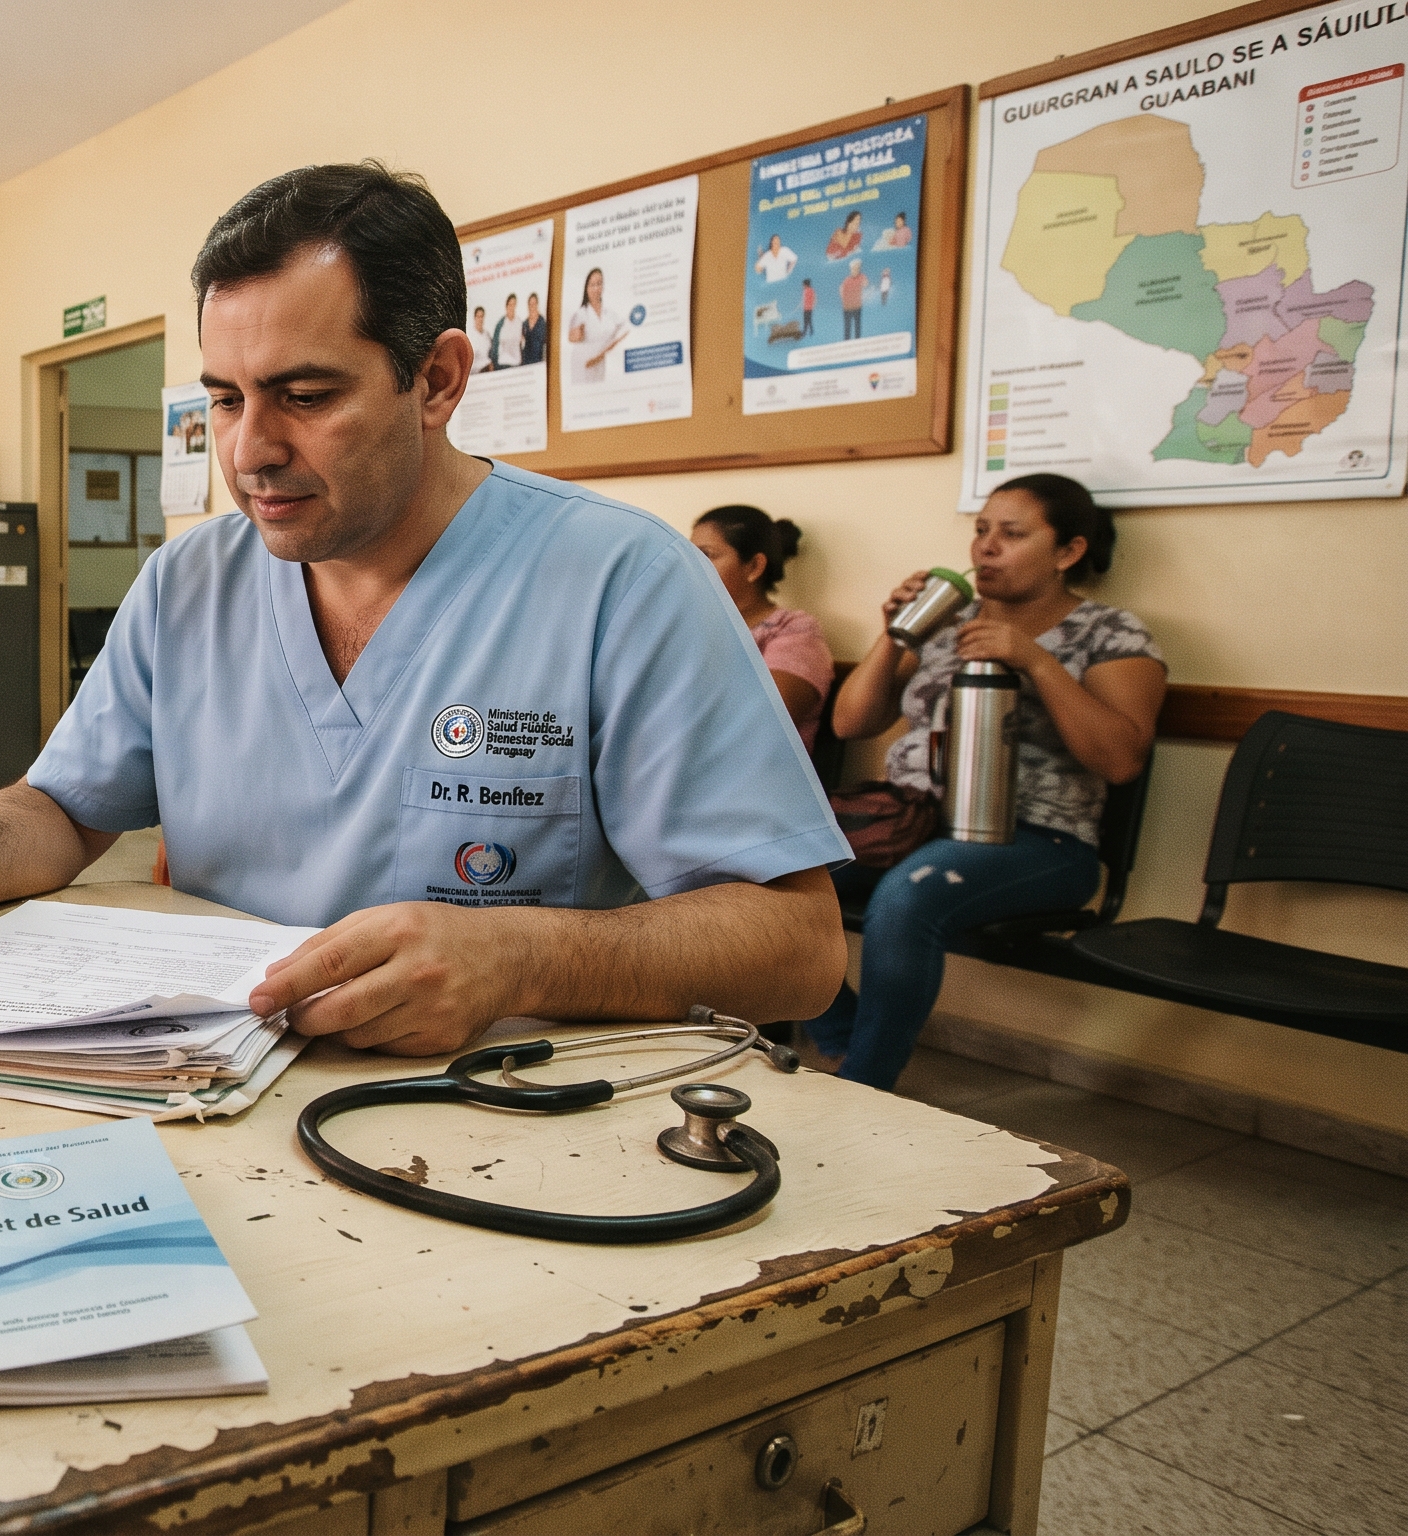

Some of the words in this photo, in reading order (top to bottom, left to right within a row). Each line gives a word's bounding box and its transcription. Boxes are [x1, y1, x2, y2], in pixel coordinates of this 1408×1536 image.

[1124, 75, 1139, 92] A
[1145, 52, 1225, 87] SAULO
[1233, 40, 1264, 64] SE
[1270, 34, 1288, 55] A
[1140, 68, 1256, 112] GUAABANI
[487, 720, 518, 732] Salud
[566, 726, 573, 737] y
[488, 708, 539, 722] Ministerio
[543, 711, 556, 723] de
[431, 781, 451, 801] Dr.
[457, 784, 473, 803] R.
[25, 1213, 61, 1229] de
[67, 1196, 150, 1223] Salud
